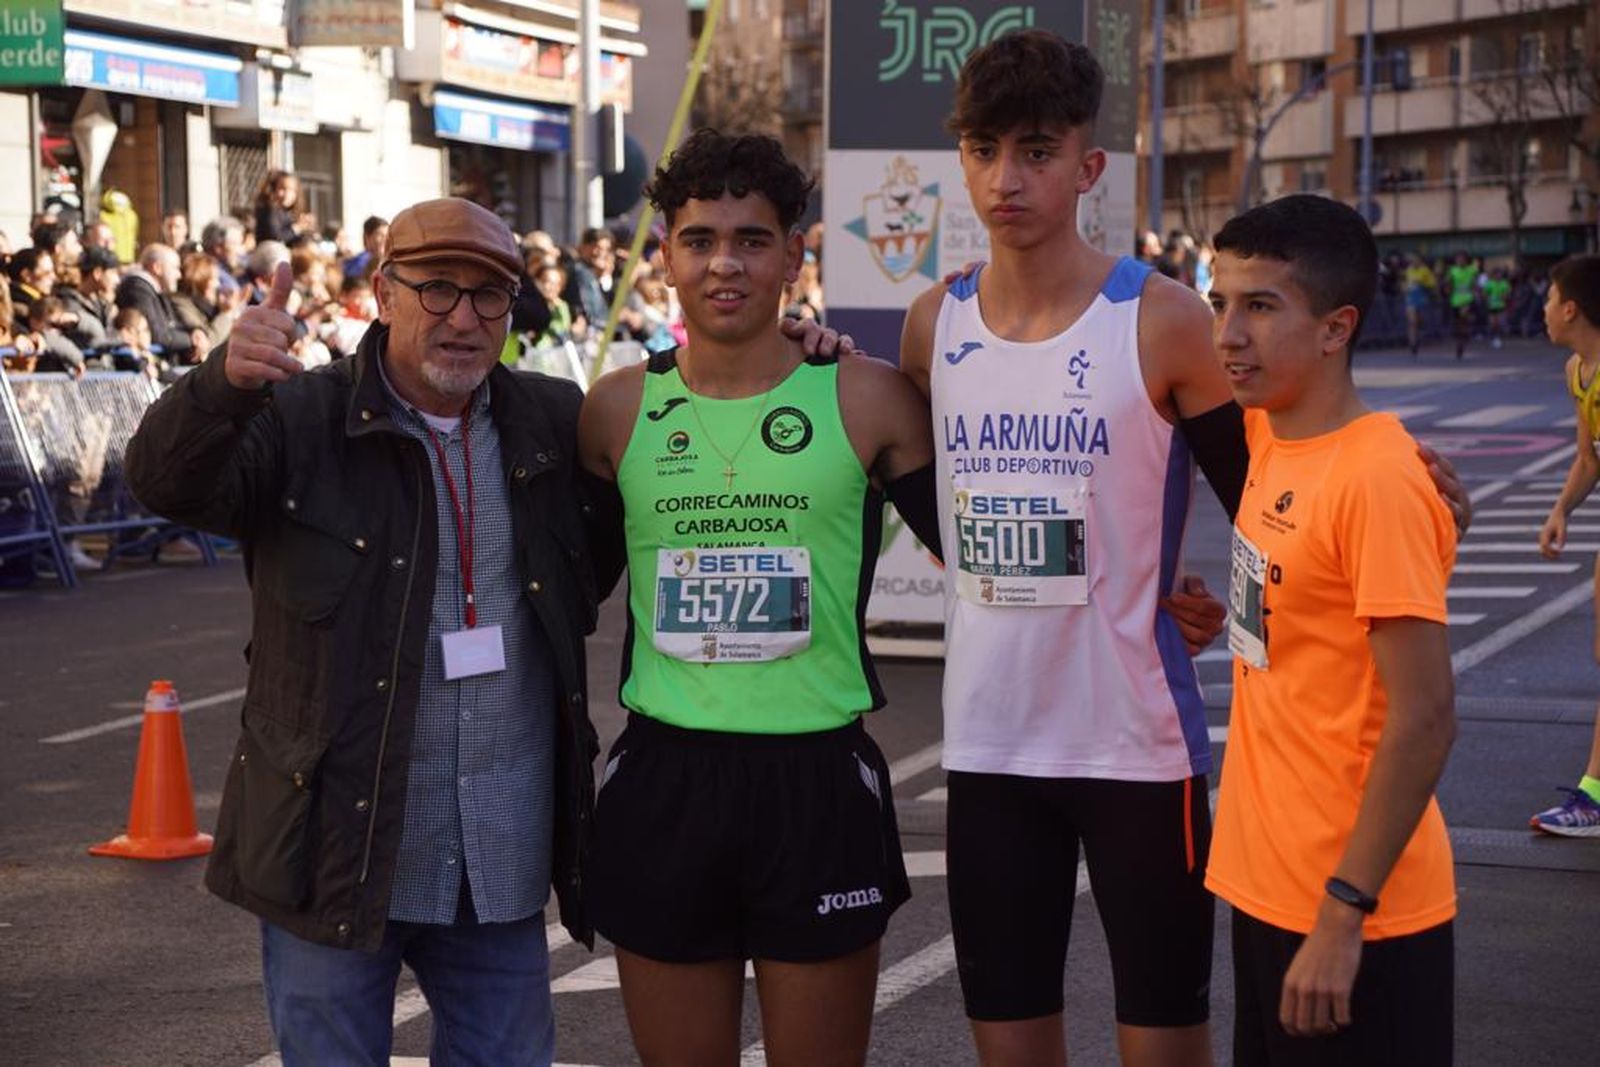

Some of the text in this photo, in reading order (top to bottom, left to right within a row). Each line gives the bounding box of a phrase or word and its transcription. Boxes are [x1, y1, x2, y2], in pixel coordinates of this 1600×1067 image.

[0, 9, 46, 36] lub
[0, 40, 58, 67] erde
[944, 407, 1110, 455] LA ARMUÑA
[955, 457, 1094, 477] CLUB DEPORTIVO
[655, 493, 810, 514] CORRECAMINOS
[971, 495, 1069, 515] SETEL
[674, 518, 788, 536] CARBAJOSA
[960, 519, 1046, 566] 5500
[699, 554, 794, 573] SETEL
[875, 577, 946, 597] RCASA
[678, 578, 770, 623] 5572
[817, 887, 882, 914] Joma
